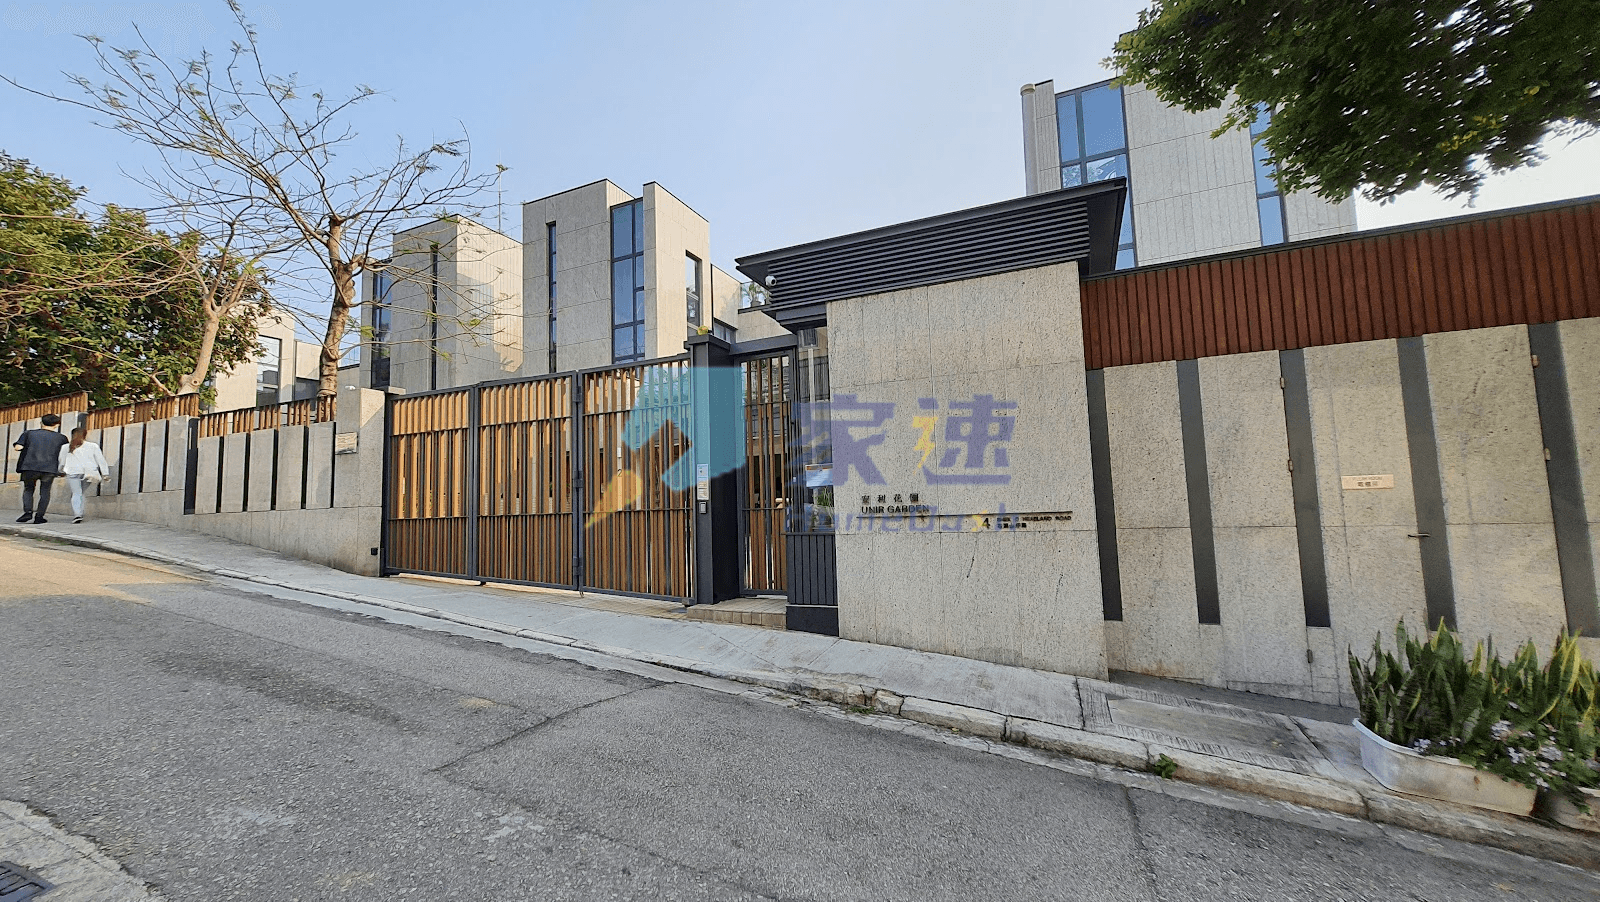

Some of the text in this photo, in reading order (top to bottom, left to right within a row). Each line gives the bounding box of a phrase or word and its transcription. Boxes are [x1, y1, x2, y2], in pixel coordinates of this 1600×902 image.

[861, 504, 930, 514] UNIR GARDEN
[981, 517, 991, 530] 4
